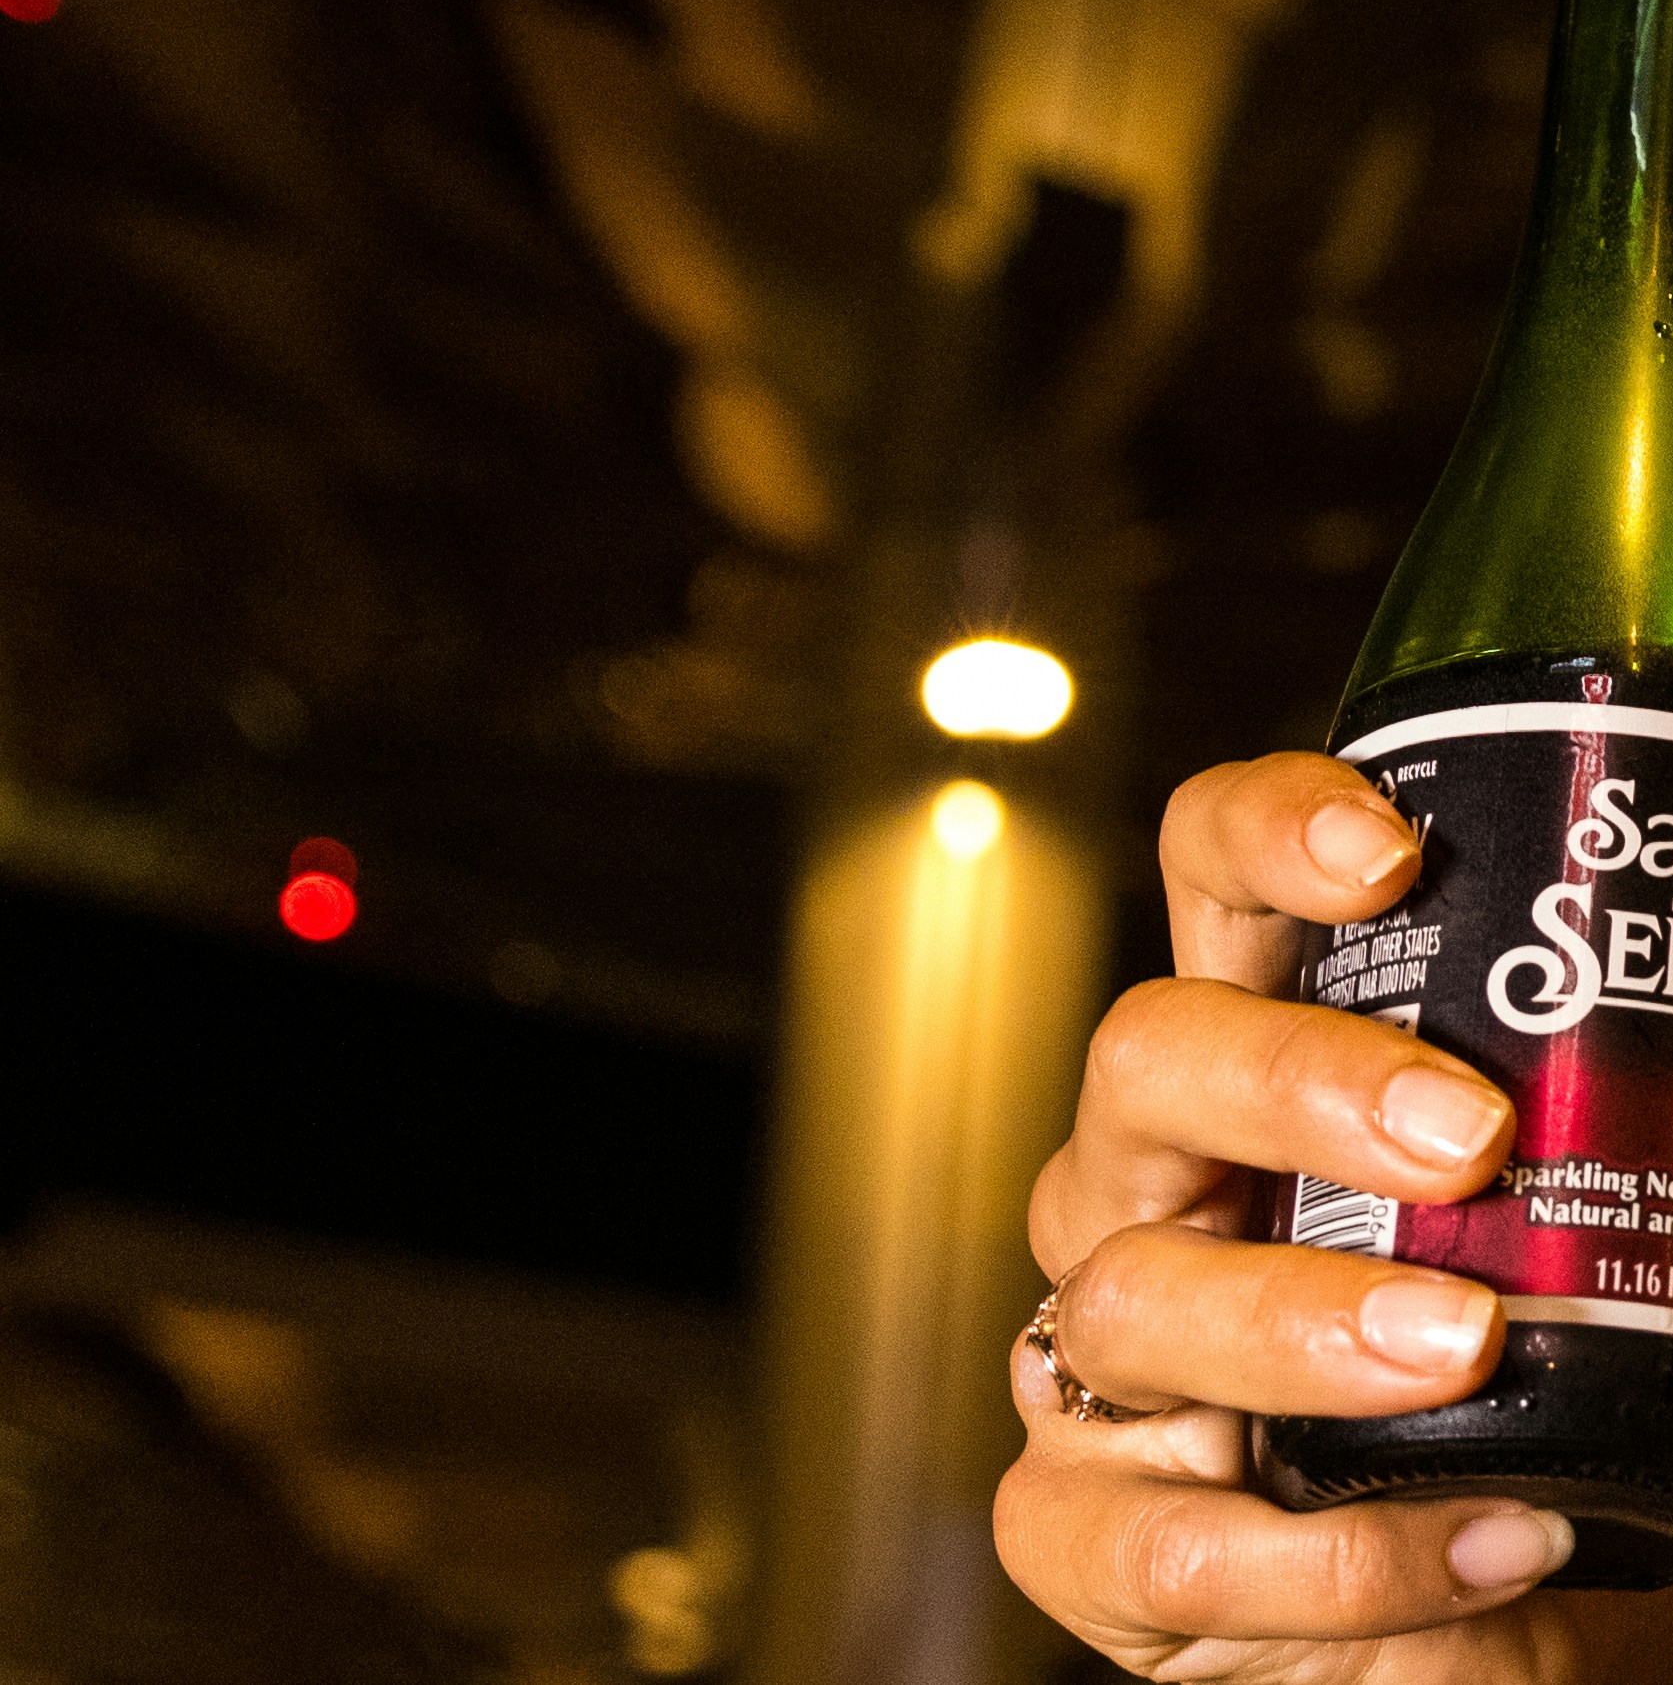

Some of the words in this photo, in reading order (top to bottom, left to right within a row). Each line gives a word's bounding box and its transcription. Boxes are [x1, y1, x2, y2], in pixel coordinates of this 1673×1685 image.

[1397, 759, 1438, 784] RECYCLE
[1371, 930, 1403, 967] OTHER
[1403, 924, 1442, 960] STATES
[1529, 1195, 1641, 1230] Natural
[1596, 1257, 1662, 1296] 11.16
